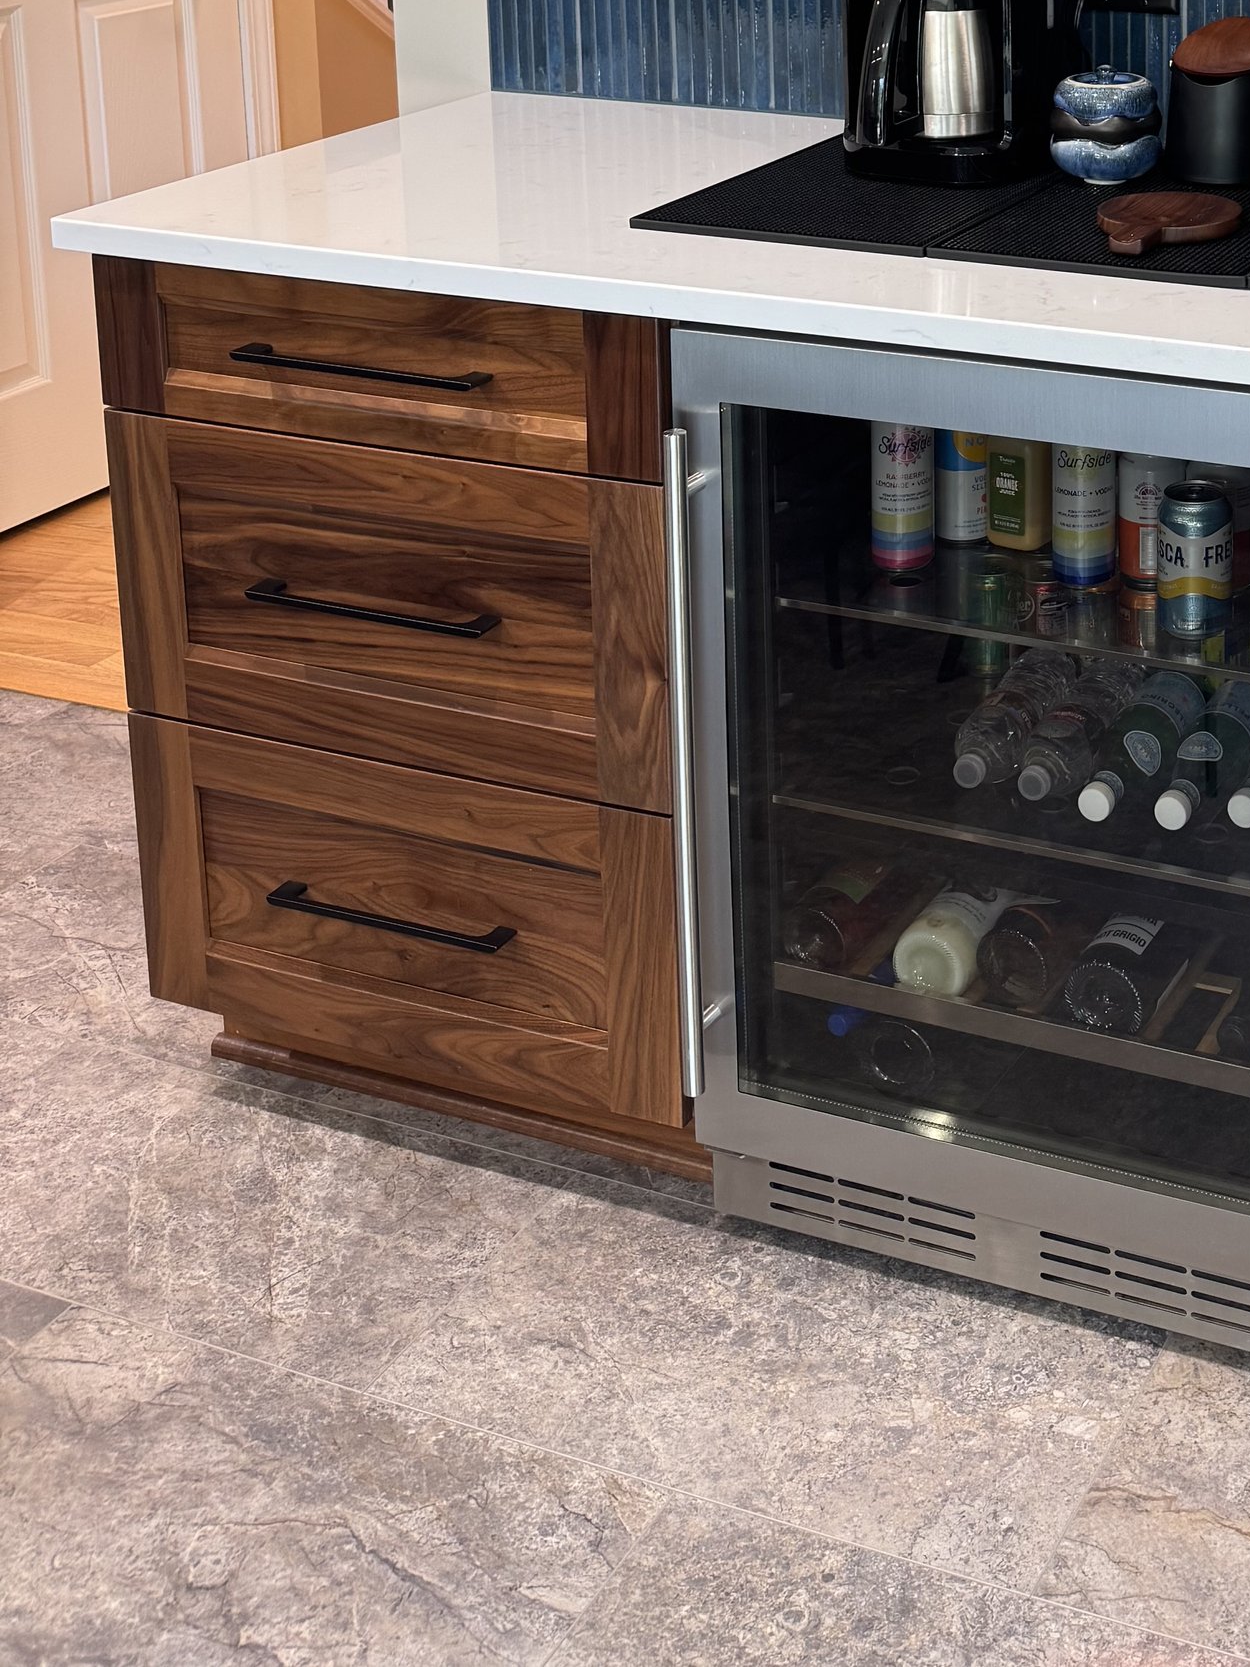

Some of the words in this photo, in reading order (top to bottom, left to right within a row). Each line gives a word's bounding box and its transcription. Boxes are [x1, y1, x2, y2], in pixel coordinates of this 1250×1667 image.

[878, 436, 932, 454] Surfside
[1058, 450, 1112, 470] Surfside
[996, 477, 1019, 491] ORANGE
[1055, 486, 1087, 497] LEMONADE
[1112, 929, 1146, 947] GRIGIO
